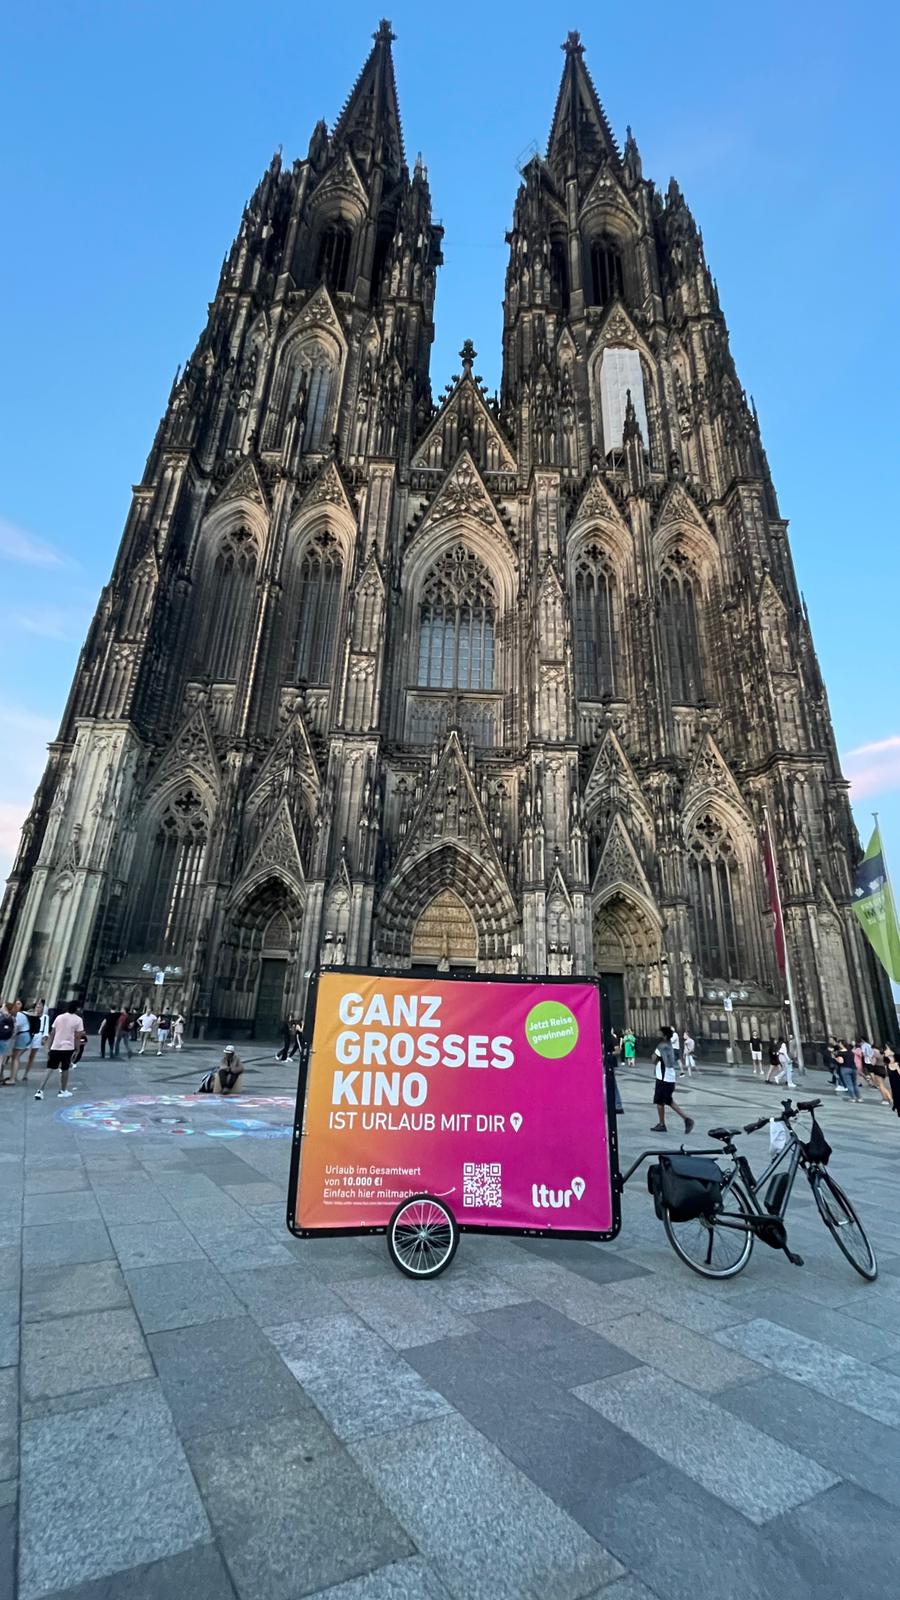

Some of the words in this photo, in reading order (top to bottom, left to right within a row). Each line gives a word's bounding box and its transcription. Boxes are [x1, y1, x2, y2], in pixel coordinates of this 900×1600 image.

[339, 993, 443, 1028] GANZ
[529, 1020, 549, 1031] Jetzt
[550, 1016, 573, 1027] Reise
[532, 1026, 574, 1044] gewinnen!
[335, 1032, 515, 1069] GROSSES
[332, 1071, 428, 1107] KINO
[329, 1112, 357, 1130] IST
[362, 1112, 436, 1132] URLAUB
[441, 1114, 472, 1132] MIT
[476, 1115, 506, 1133] DIR
[325, 1165, 355, 1175] Urlaub
[356, 1166, 368, 1175] im
[369, 1165, 422, 1176] Gesamtwert
[324, 1178, 340, 1187] von
[343, 1177, 372, 1187] 10.000
[374, 1177, 383, 1187] €!
[323, 1188, 356, 1198] Einfach
[358, 1189, 375, 1198] hier
[532, 1183, 573, 1208] ltur
